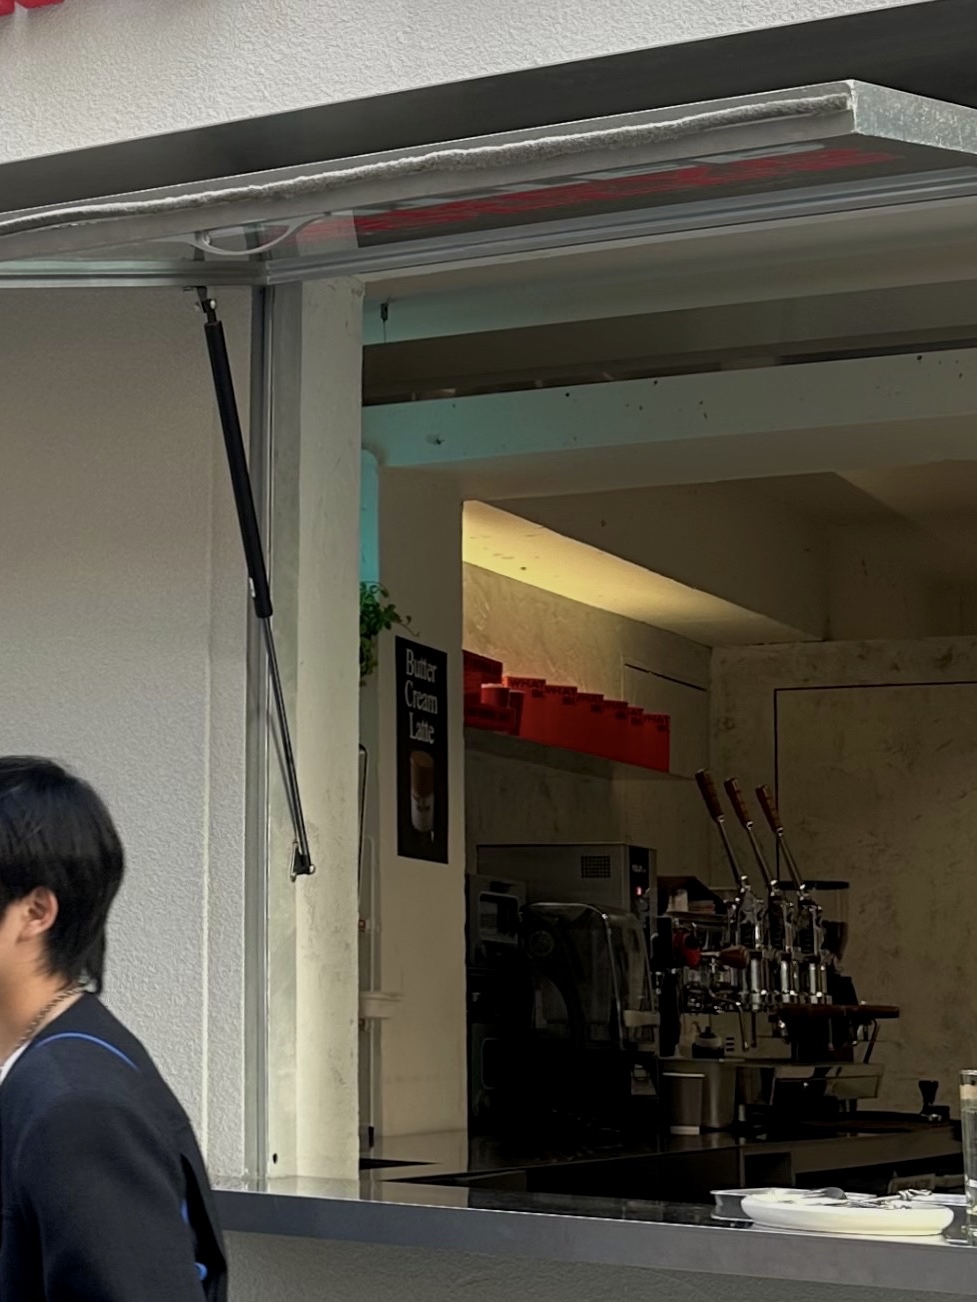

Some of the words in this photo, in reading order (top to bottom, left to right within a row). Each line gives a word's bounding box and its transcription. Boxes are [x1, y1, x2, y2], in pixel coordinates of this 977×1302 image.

[405, 647, 438, 683] Butter
[404, 680, 438, 714] Cream
[409, 711, 435, 745] Latte
